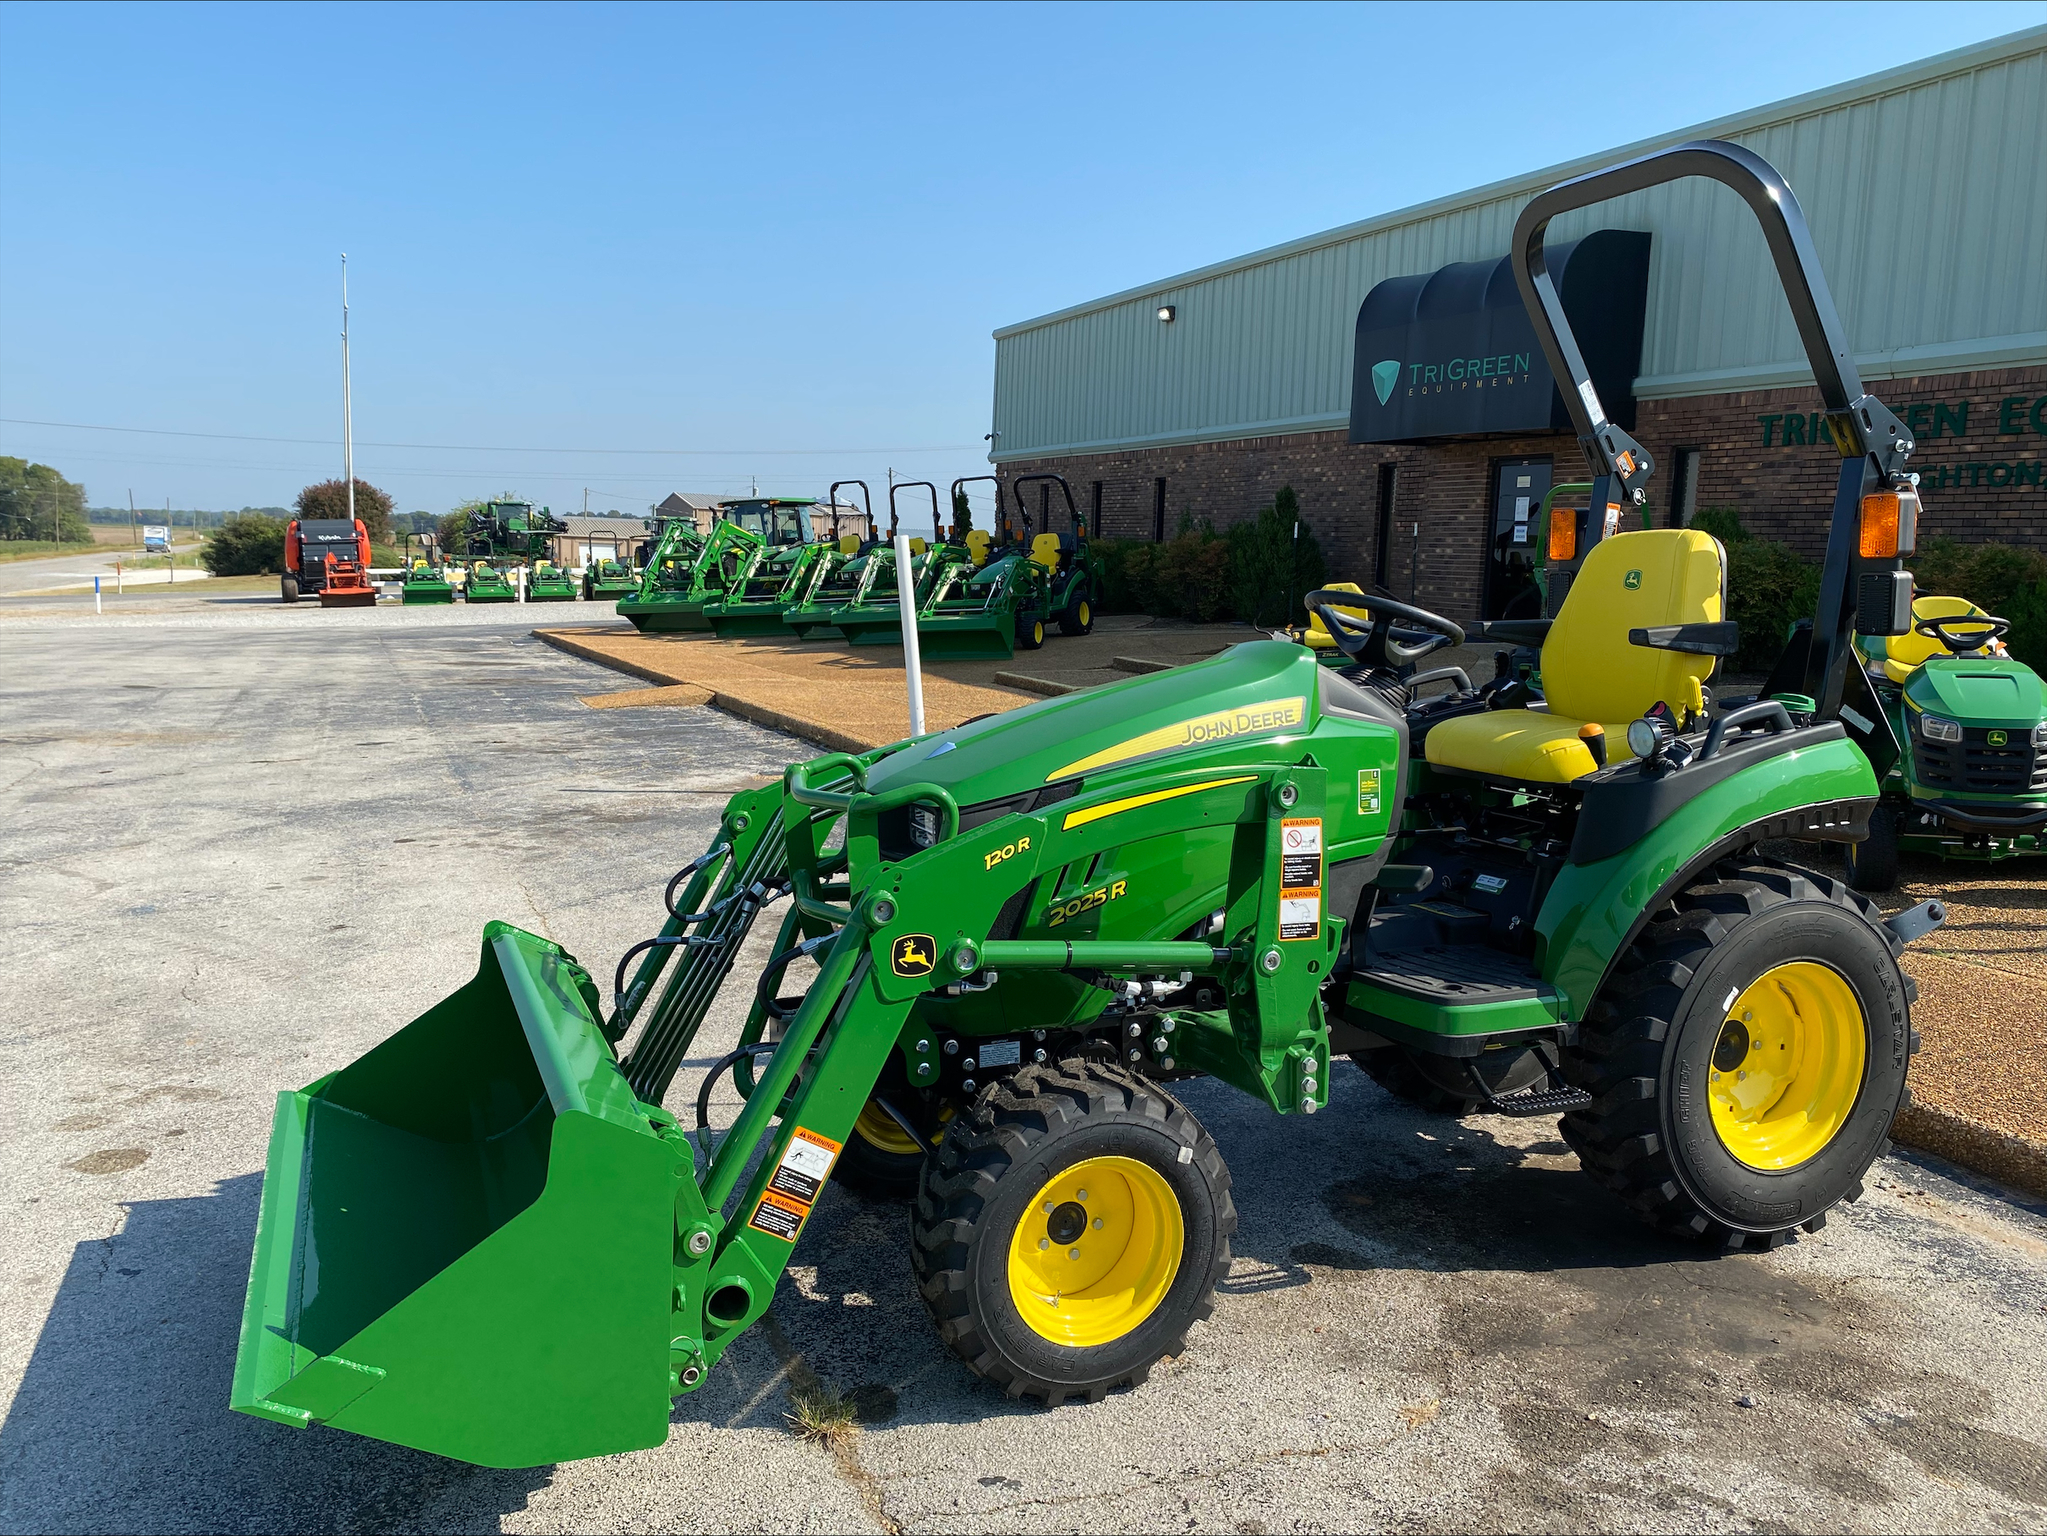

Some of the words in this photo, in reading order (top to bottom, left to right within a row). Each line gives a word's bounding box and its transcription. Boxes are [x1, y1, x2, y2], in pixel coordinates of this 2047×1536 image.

[1409, 352, 1531, 386] TRIGREEN
[1408, 374, 1529, 397] EQUIPMENT
[1181, 718, 1233, 747] JOHN
[1236, 708, 1296, 734] DEERE
[1289, 818, 1320, 826] WARNING
[984, 843, 1016, 872] 120
[1017, 835, 1032, 855] R
[1048, 886, 1106, 928] 2025
[1110, 879, 1128, 901] R
[1289, 890, 1319, 898] WARNING
[806, 1133, 836, 1150] WARNING
[774, 1198, 804, 1214] WARNING
